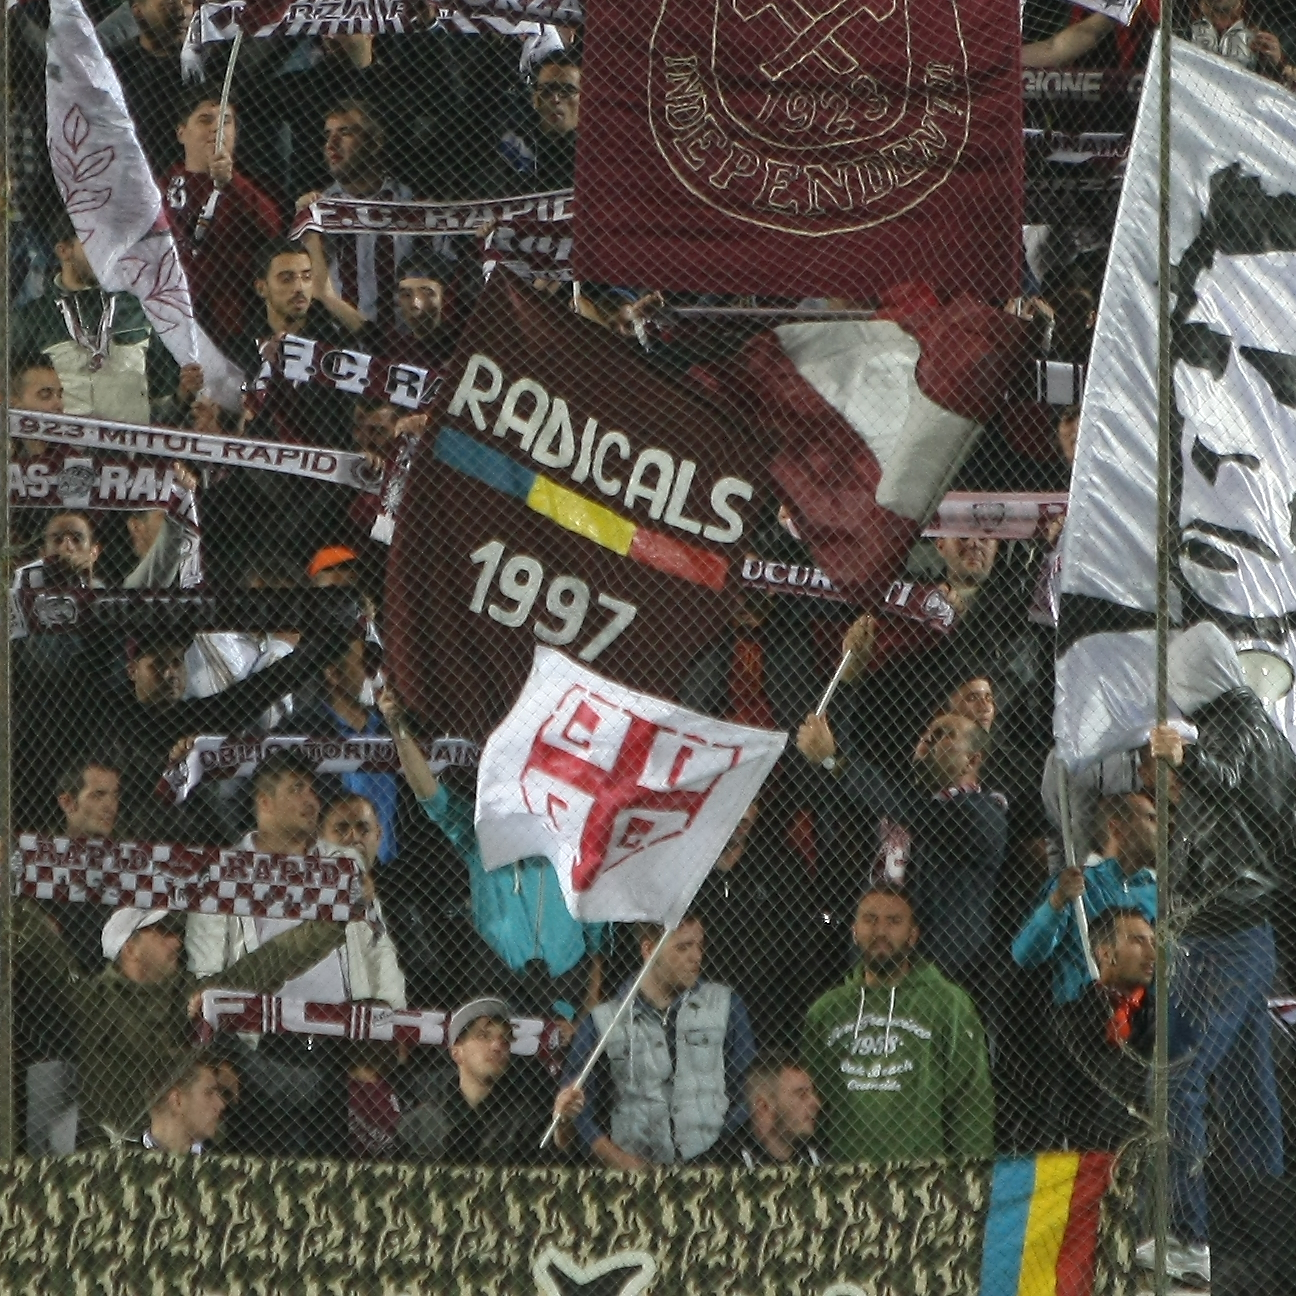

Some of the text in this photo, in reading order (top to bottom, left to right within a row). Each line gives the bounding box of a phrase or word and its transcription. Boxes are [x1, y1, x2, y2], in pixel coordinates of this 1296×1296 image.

[760, 73, 891, 135] 1923
[1022, 71, 1102, 101] GIONE
[18, 417, 338, 476] 923 MITUL RAPID
[446, 353, 754, 544] RADICALS
[469, 539, 638, 662] 1997
